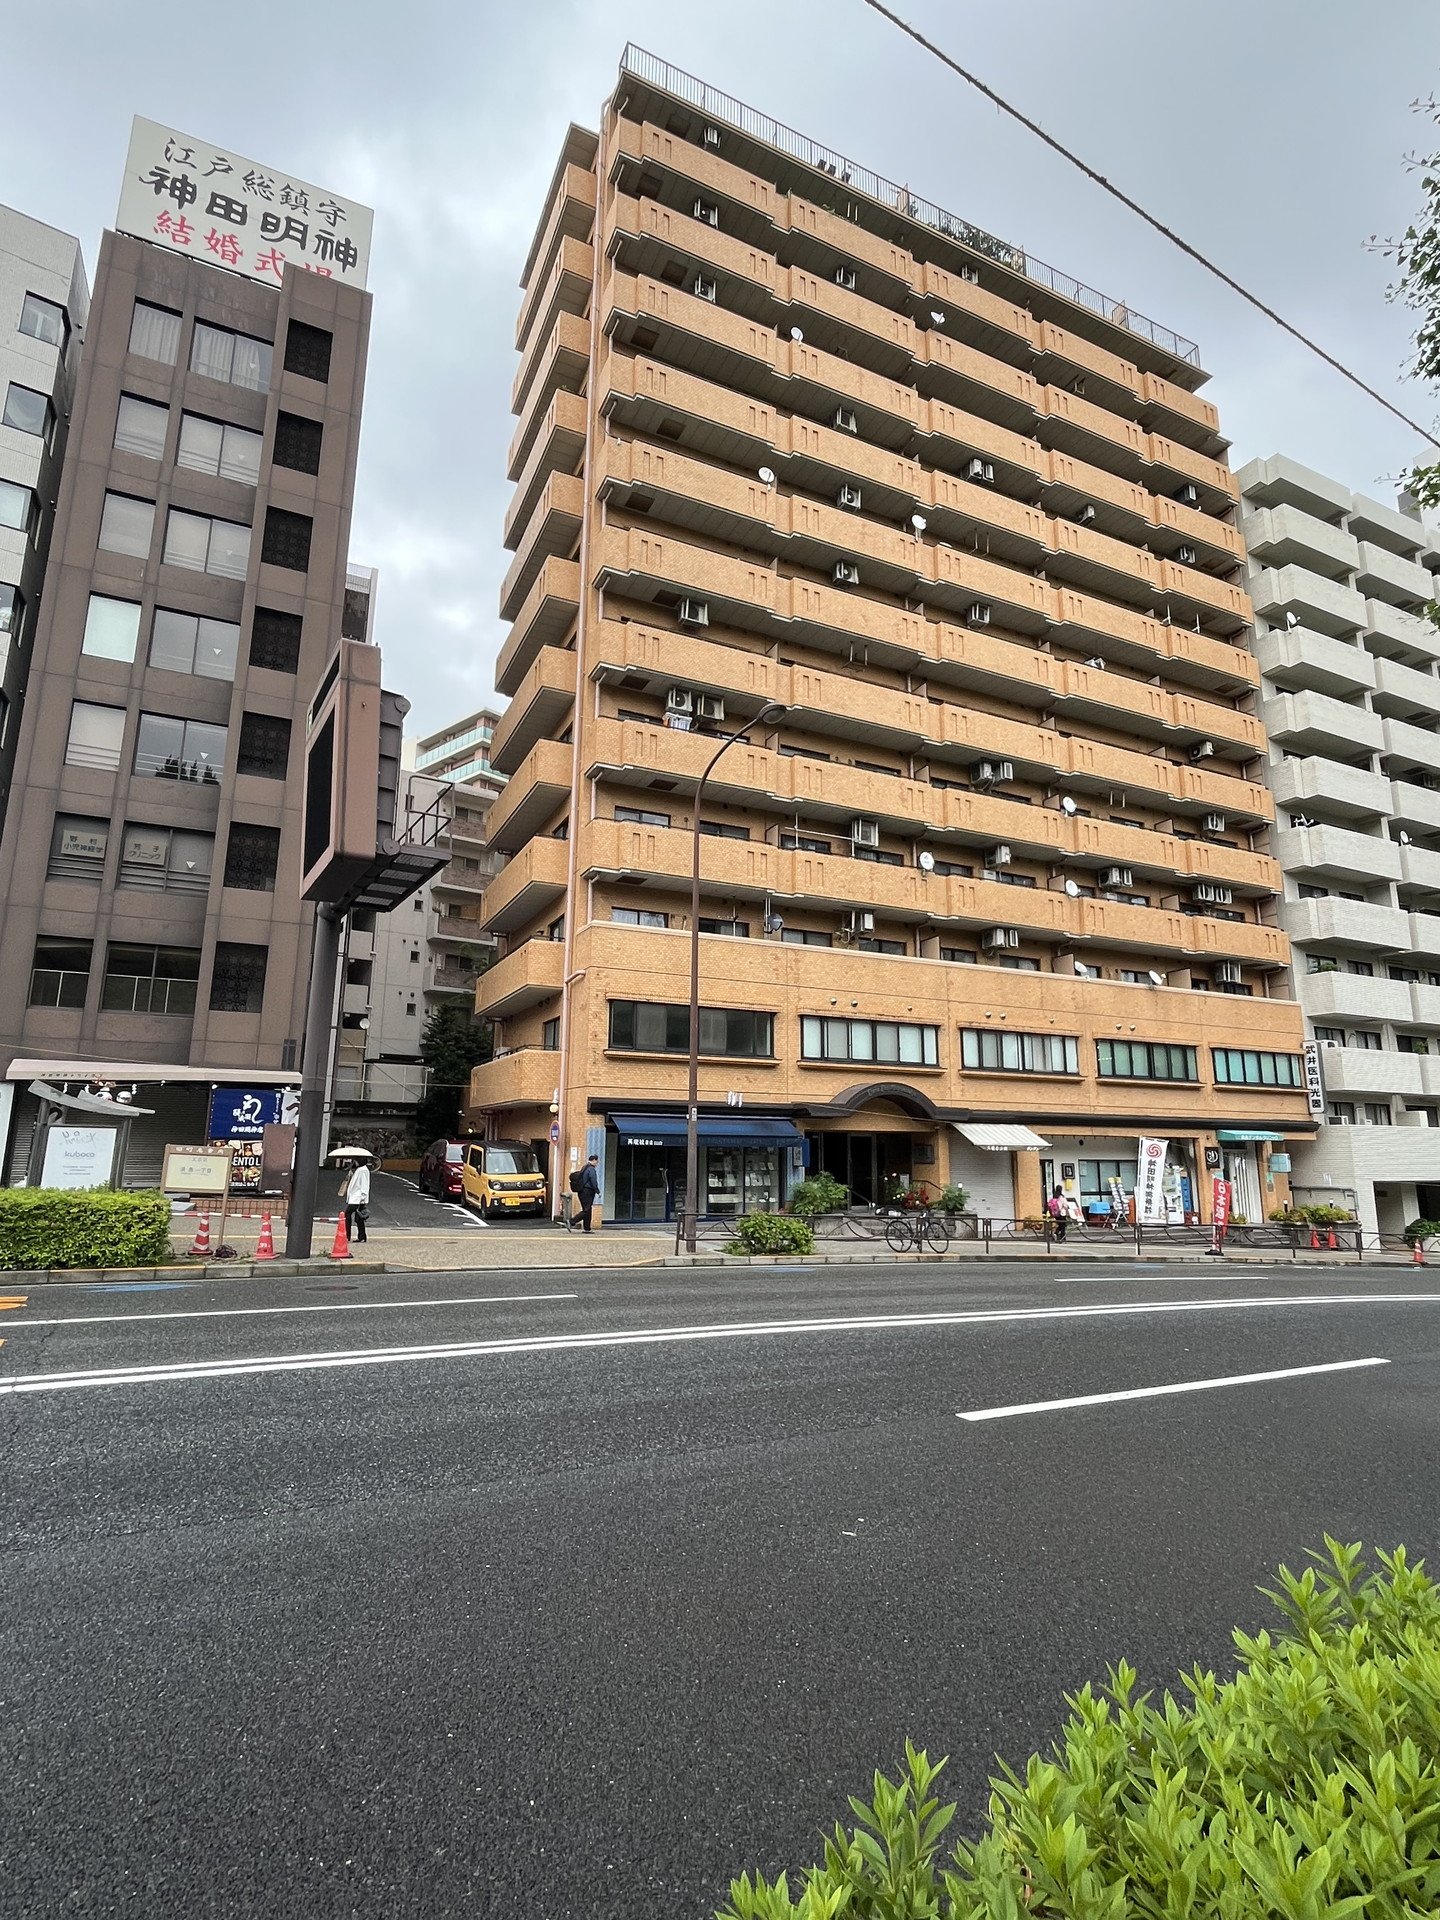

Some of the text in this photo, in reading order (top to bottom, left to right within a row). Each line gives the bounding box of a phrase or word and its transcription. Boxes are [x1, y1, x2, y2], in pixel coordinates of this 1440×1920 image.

[138, 166, 358, 273] 神田明神
[164, 137, 347, 227] 江戸総鎮守
[233, 1157, 255, 1166] ENTO
